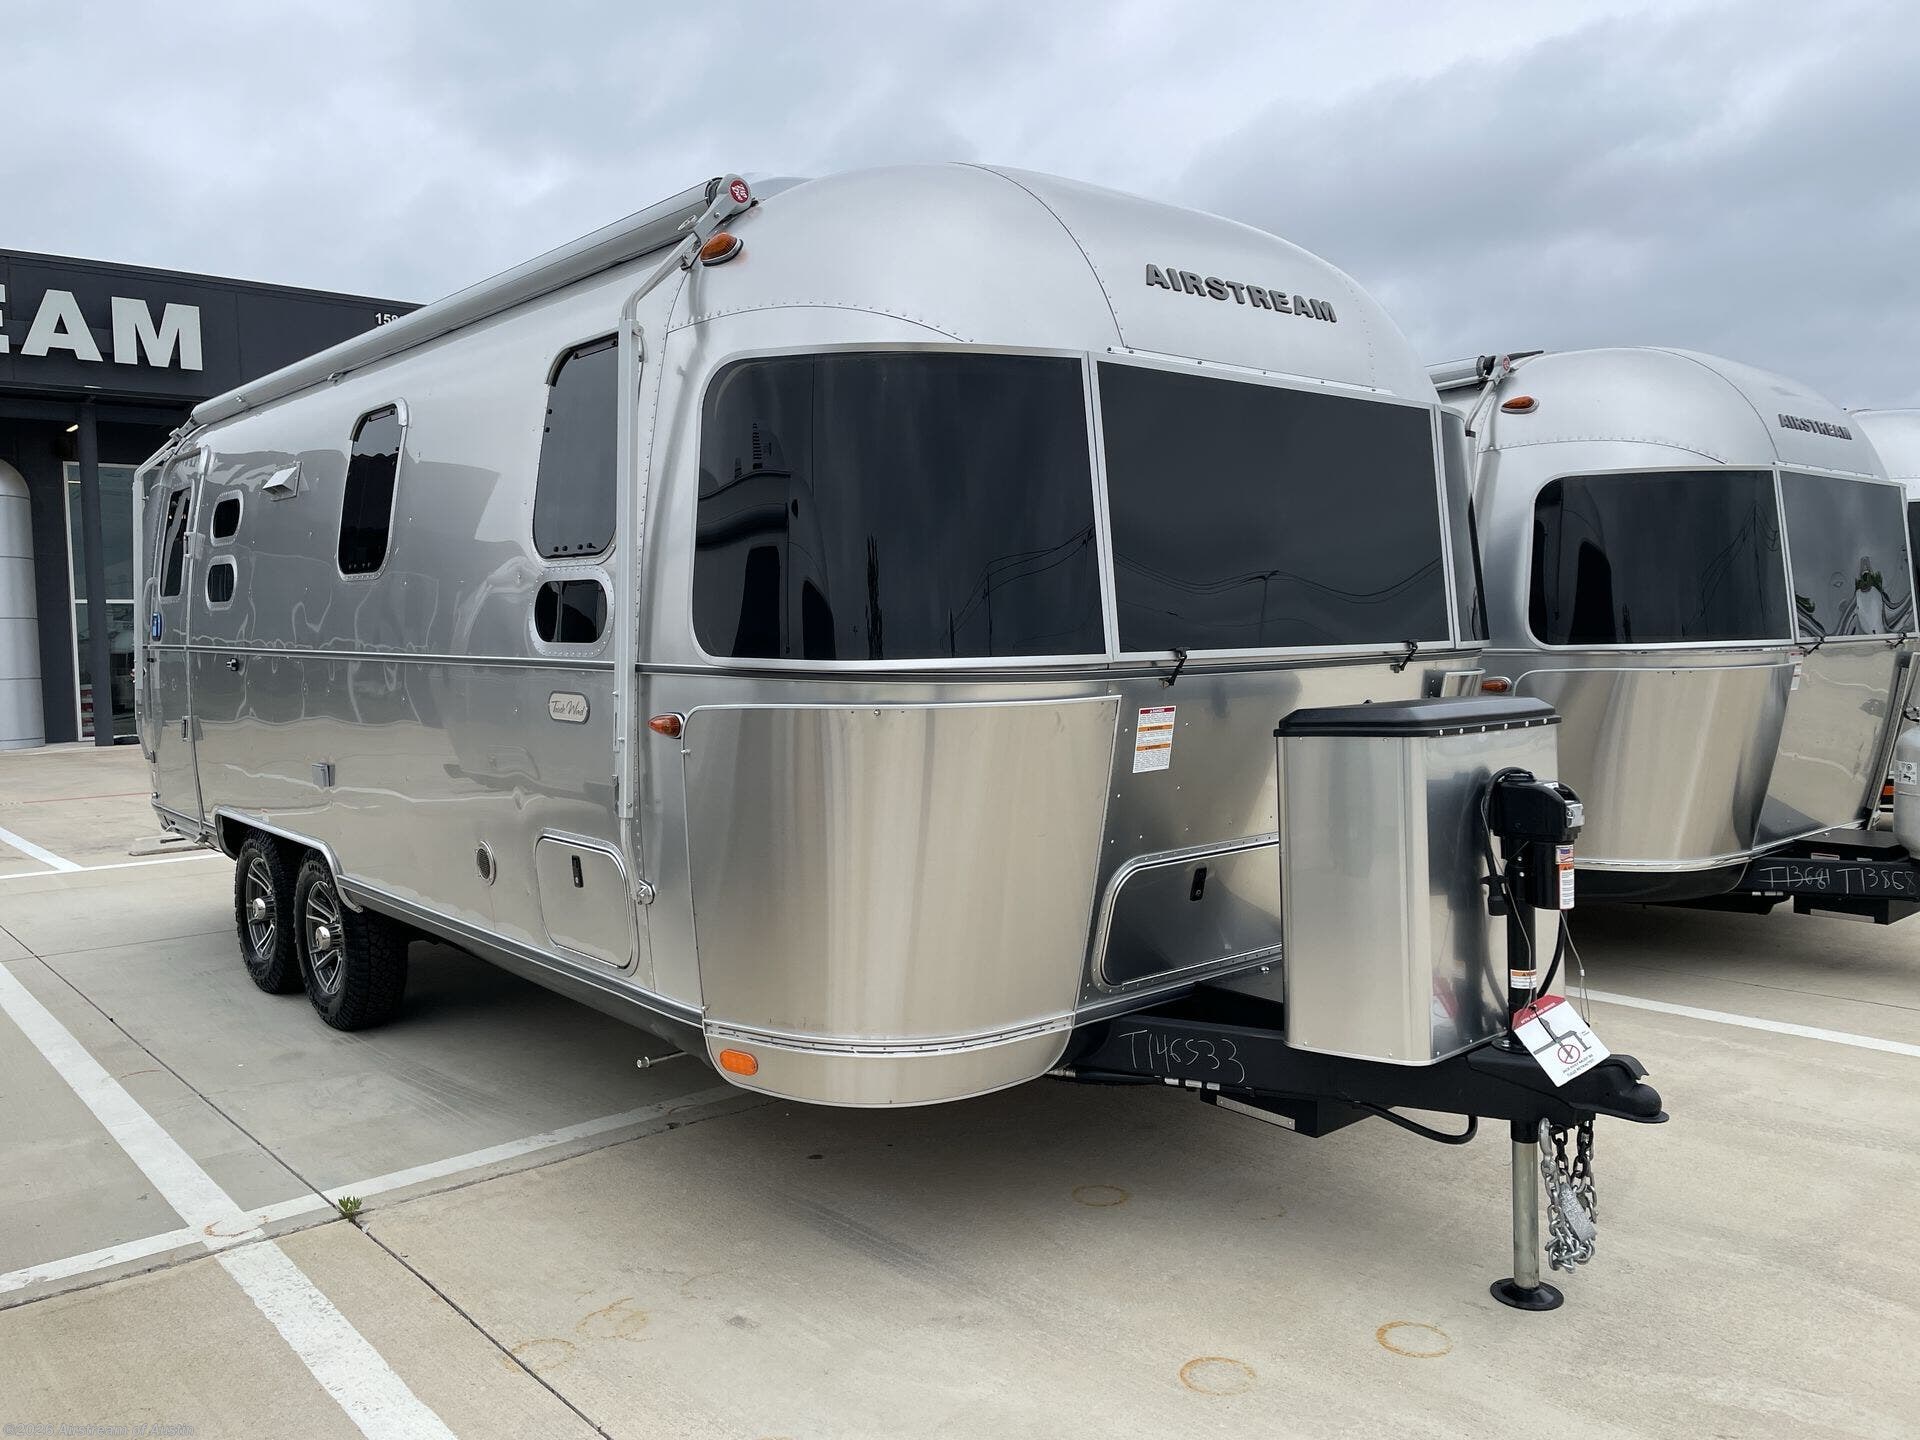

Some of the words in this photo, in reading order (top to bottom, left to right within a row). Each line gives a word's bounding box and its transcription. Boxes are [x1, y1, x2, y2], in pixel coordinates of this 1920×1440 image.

[1145, 263, 1338, 323] AIRSTREAM
[0, 284, 203, 371] AM
[1778, 413, 1852, 440] AIRSTREAM
